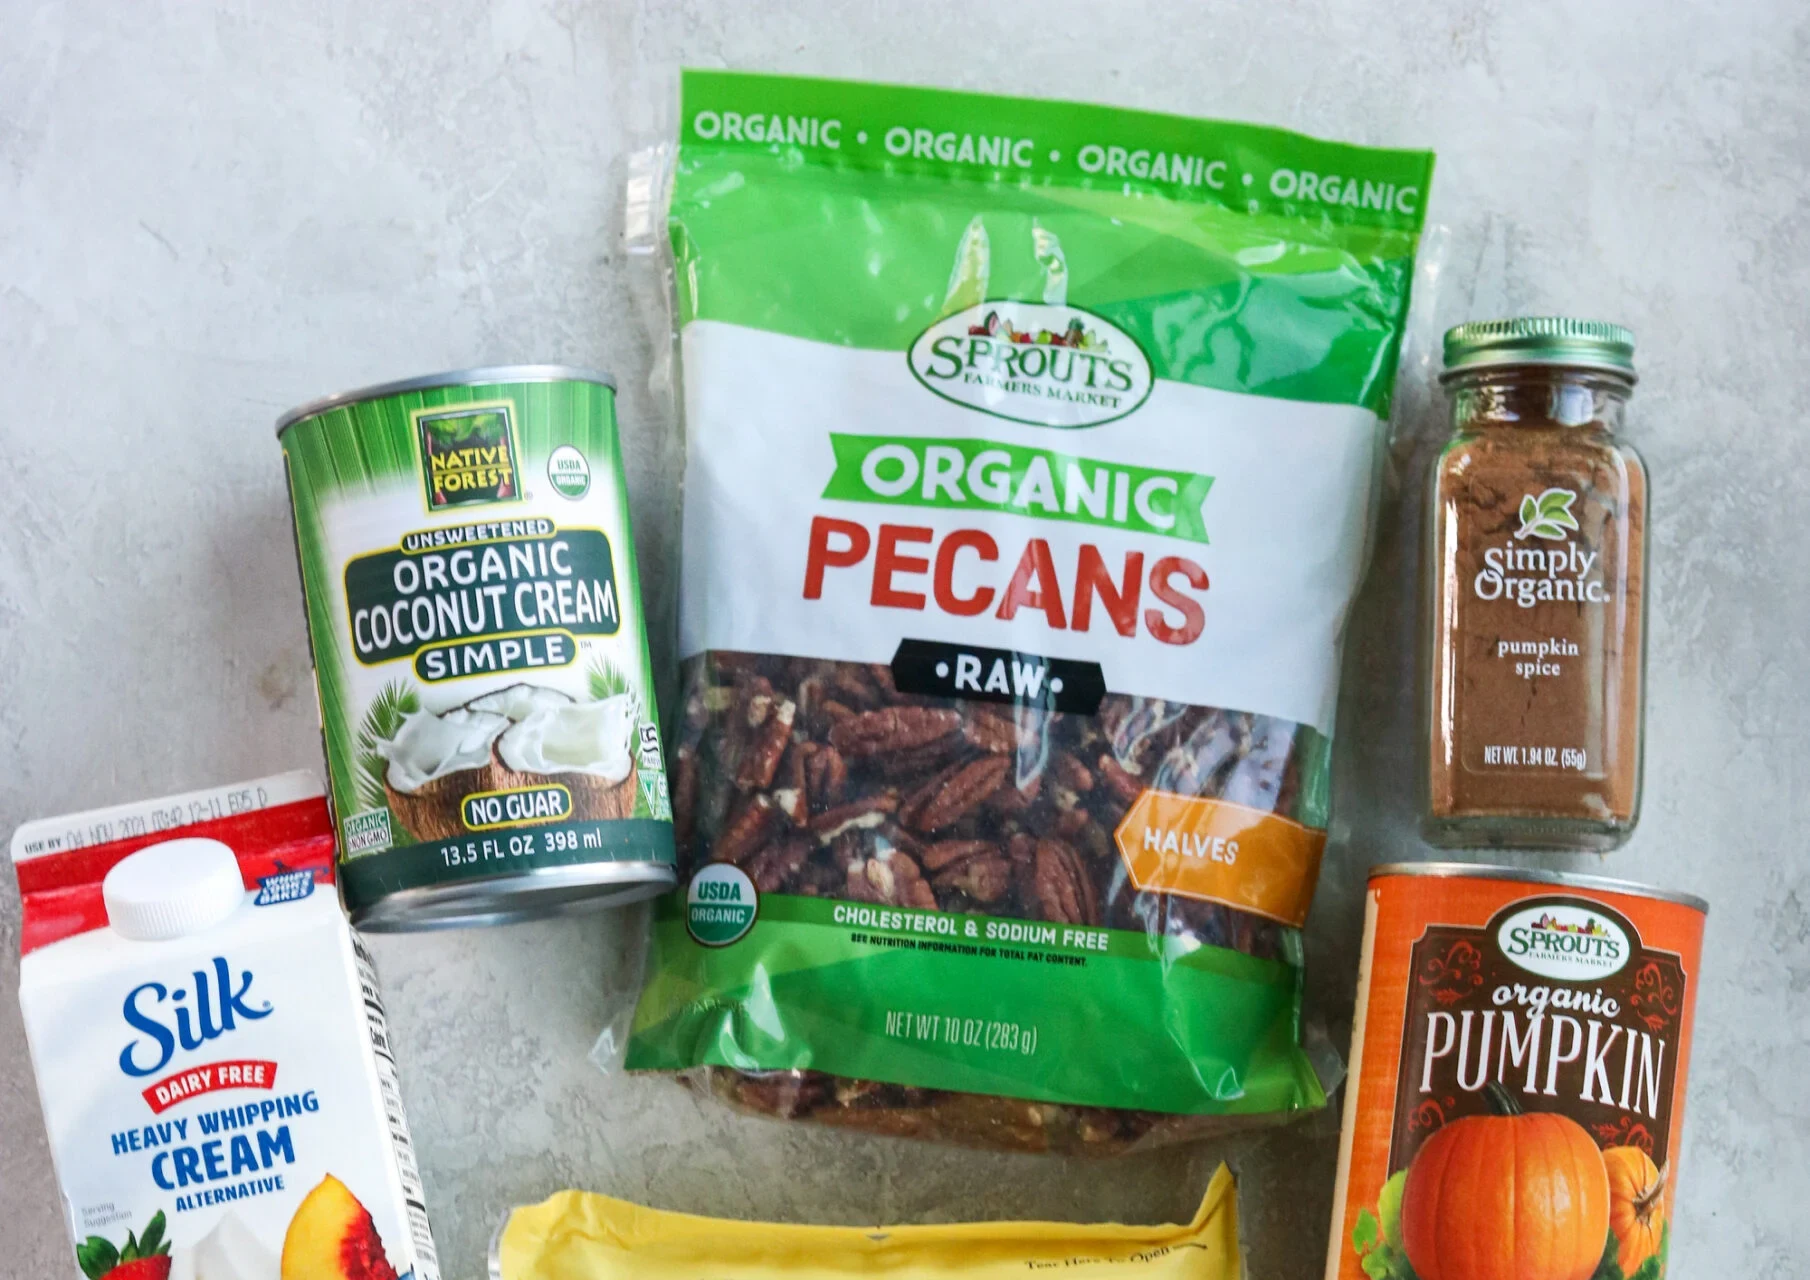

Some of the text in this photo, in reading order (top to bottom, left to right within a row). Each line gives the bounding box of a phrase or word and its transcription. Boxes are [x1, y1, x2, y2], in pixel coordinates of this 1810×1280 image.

[694, 110, 1418, 215] ORGANIC ORGANIC ORGANIC ORGANIC
[925, 335, 1134, 392] SPROUTS
[964, 373, 1123, 409] FARMERS MARKET
[430, 445, 509, 471] NATIVE
[432, 467, 513, 493] FOREST
[861, 443, 1179, 530] ORGANIC
[406, 519, 550, 550] UNSWEETENED
[393, 541, 573, 594] ORGANIC
[1484, 540, 1597, 580] Simply
[802, 514, 1211, 647] PECANS
[354, 579, 618, 654] COCONUT CREAM
[425, 635, 567, 680] SIMPLE
[1497, 637, 1580, 660] pumpkin
[955, 652, 1046, 700] RAW
[1515, 658, 1561, 680] spice
[1484, 745, 1501, 765] NET
[1521, 747, 1542, 766] 1.94
[1561, 748, 1587, 771] (55g)
[471, 791, 563, 824] NO GUAR
[441, 828, 603, 867] 13.5 FL OZ 398 ml
[1143, 825, 1240, 866] HALVES
[697, 881, 742, 902] USDA
[691, 907, 746, 924] ORGANIC
[834, 904, 1109, 951] CHOLESTEROL & SODIUM FREE
[851, 932, 1045, 962] SEE NUTRITION INFORMATION FOR TOTAL FAT
[1507, 927, 1621, 959] SPROUTS
[118, 955, 274, 1077] Silk
[1492, 983, 1621, 1020] organic
[886, 1010, 1039, 1056] NET WT 10 OZ (283 g)
[1418, 1009, 1666, 1120] PUMPKIN
[155, 1064, 266, 1106] DAIRY FREE
[111, 1090, 320, 1157] HEAVY WHIPPING
[151, 1124, 296, 1191] CREAM
[176, 1174, 285, 1213] ALTERNATIVE
[1129, 1246, 1170, 1264] Open
